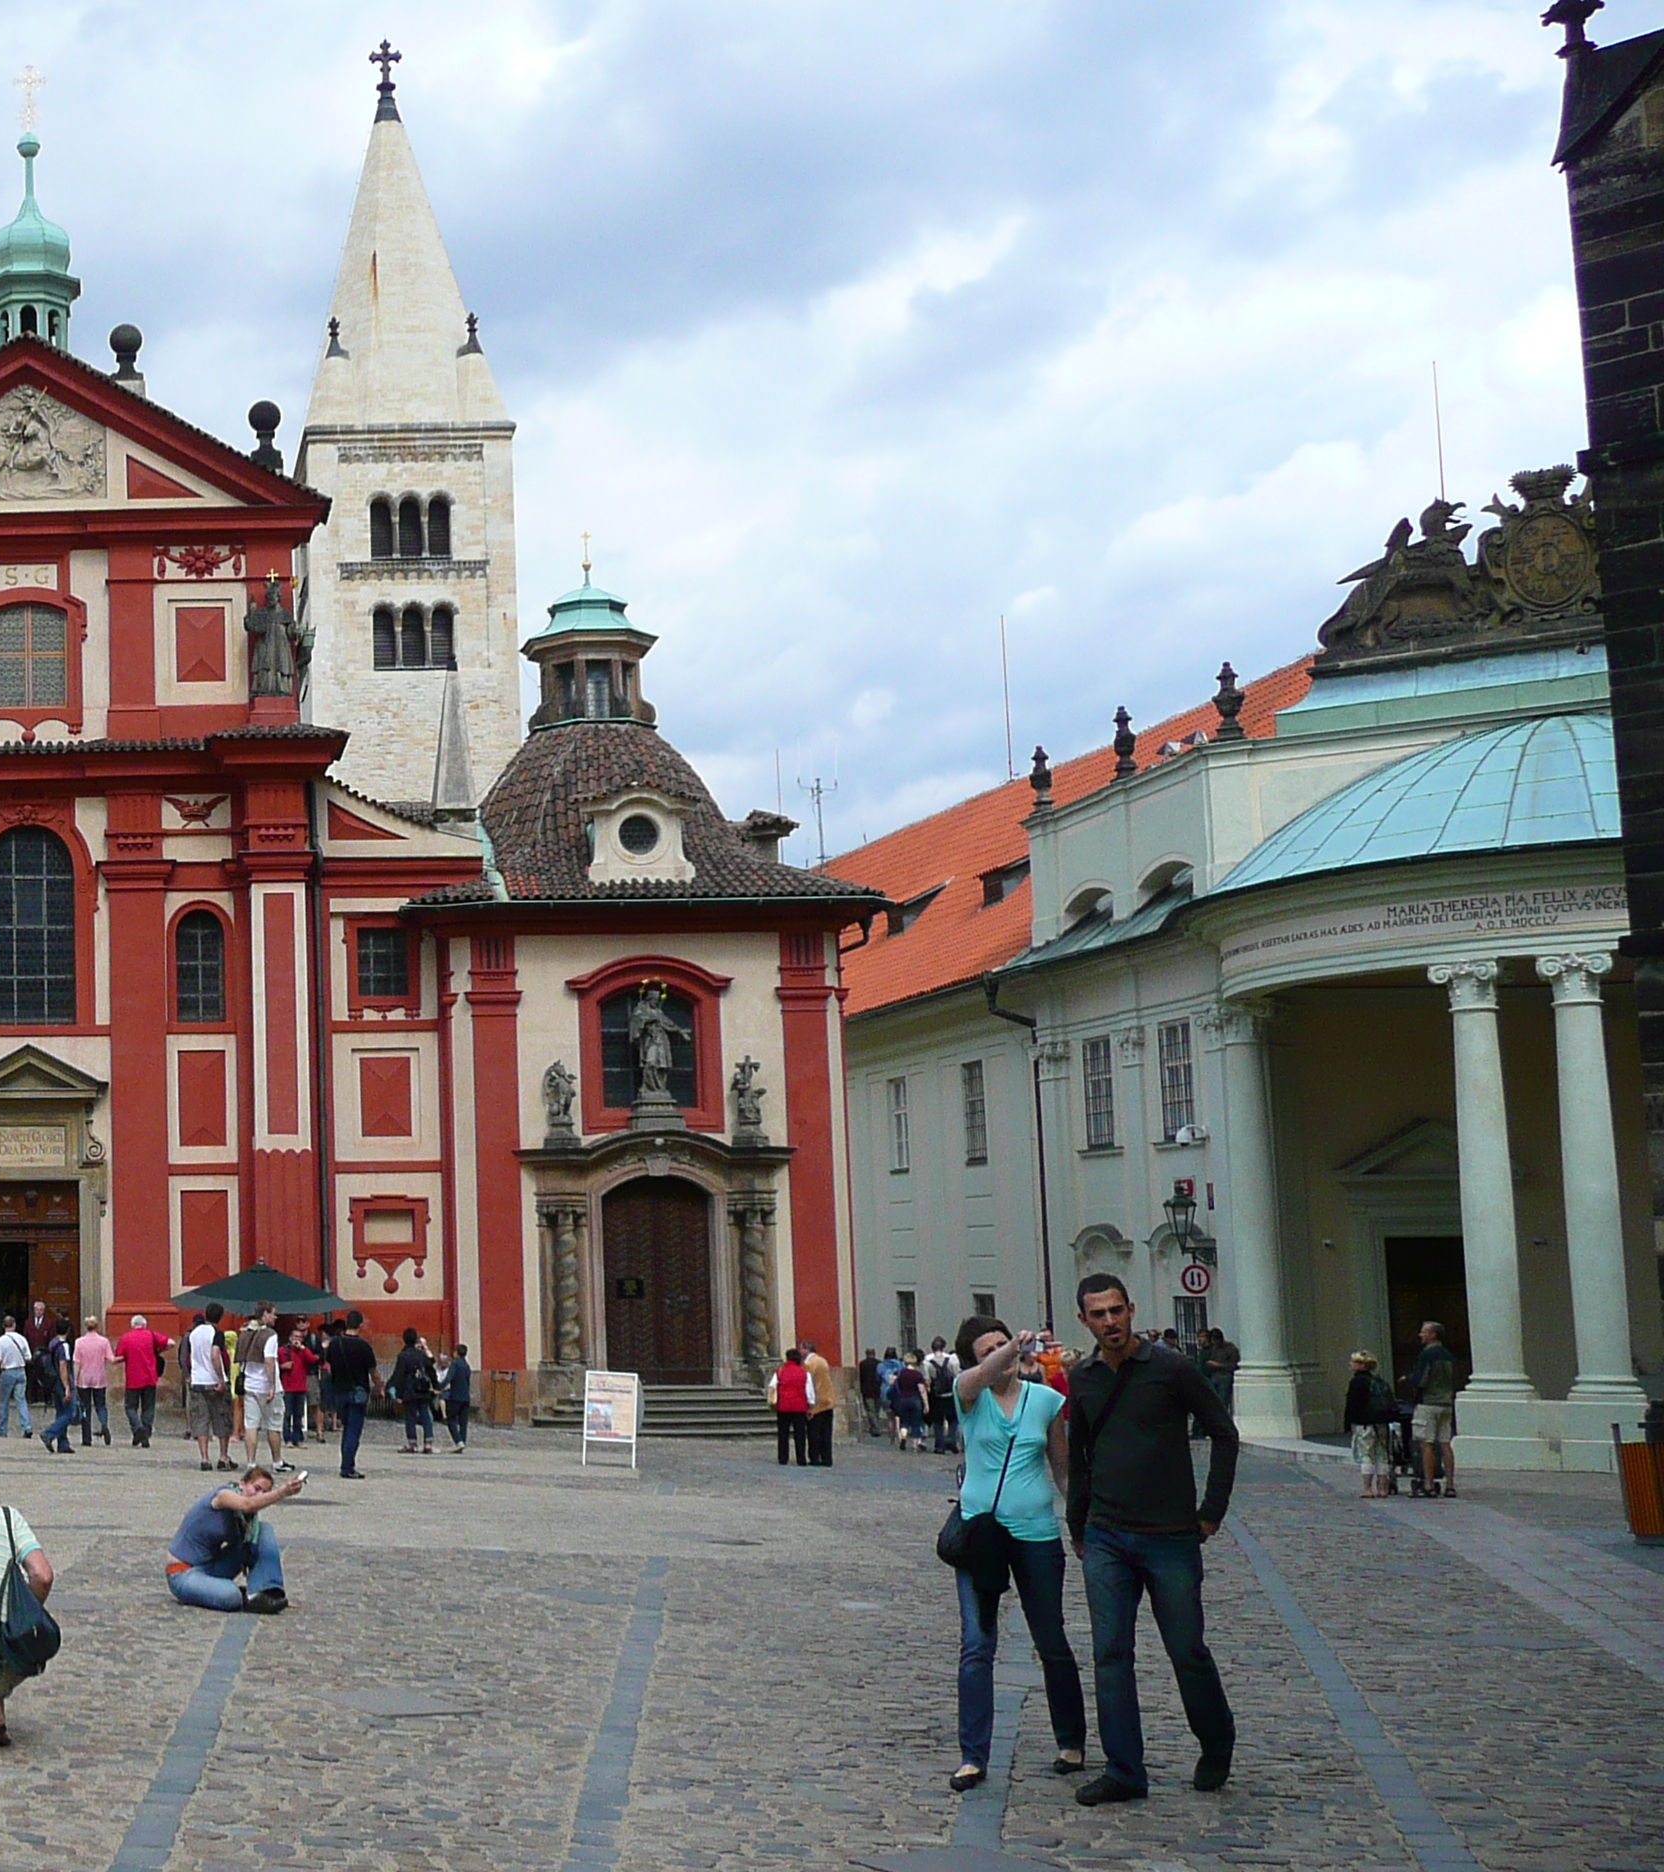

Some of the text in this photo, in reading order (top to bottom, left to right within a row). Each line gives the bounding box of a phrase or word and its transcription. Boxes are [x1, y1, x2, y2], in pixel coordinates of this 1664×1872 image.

[1387, 902, 1430, 917] MARIA
[1430, 892, 1499, 913] THERESIA
[1505, 892, 1527, 906] PIA
[1533, 887, 1576, 904] FELIX
[1320, 927, 1338, 938] HAS
[1367, 922, 1381, 931] AD
[1506, 904, 1540, 917] DIVINI
